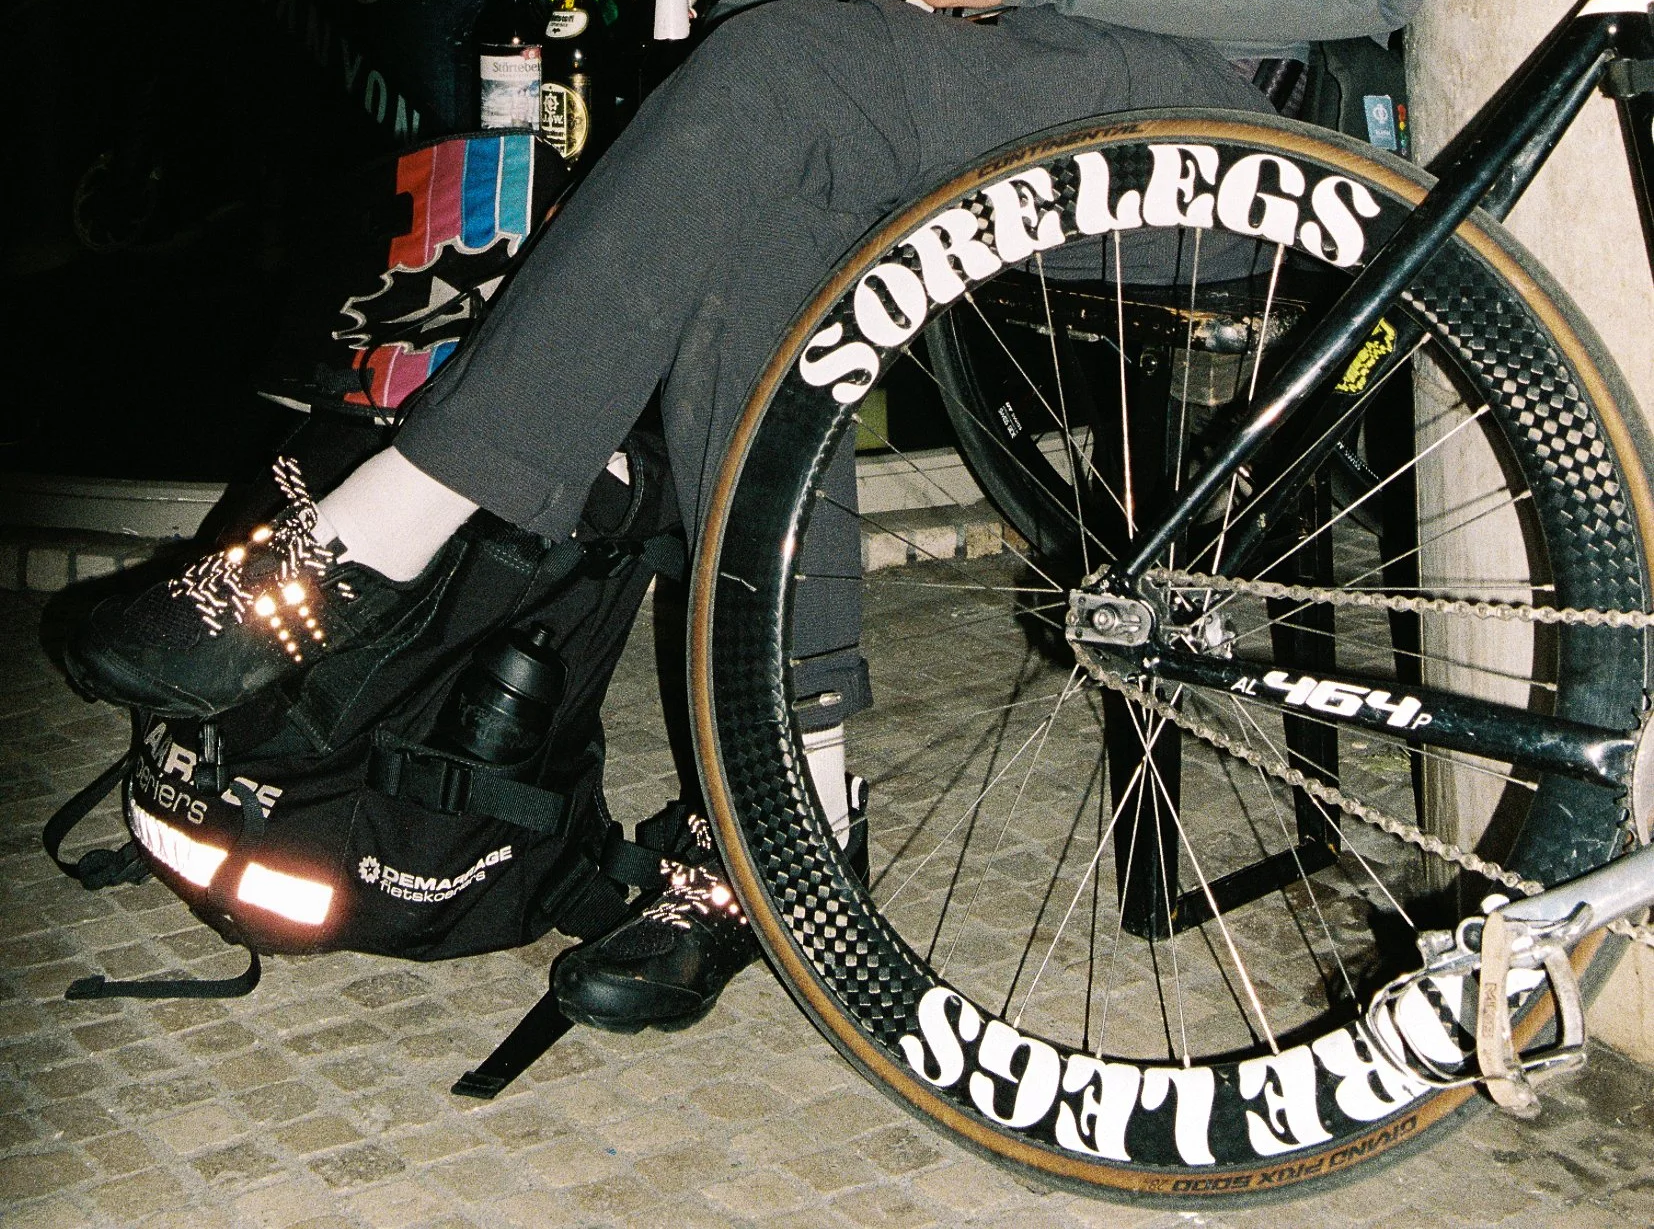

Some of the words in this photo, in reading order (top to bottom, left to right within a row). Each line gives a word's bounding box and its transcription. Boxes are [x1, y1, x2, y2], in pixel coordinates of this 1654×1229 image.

[799, 167, 1066, 404] SORE
[1073, 143, 1380, 268] LEGS
[382, 845, 513, 891] DEMARRAGE
[900, 986, 1216, 1166] LEGS
[1238, 968, 1546, 1158] ORE
[1329, 1114, 1418, 1168] GRAND
[1171, 1173, 1251, 1192] 5000
[1257, 1157, 1325, 1185] PRIX
